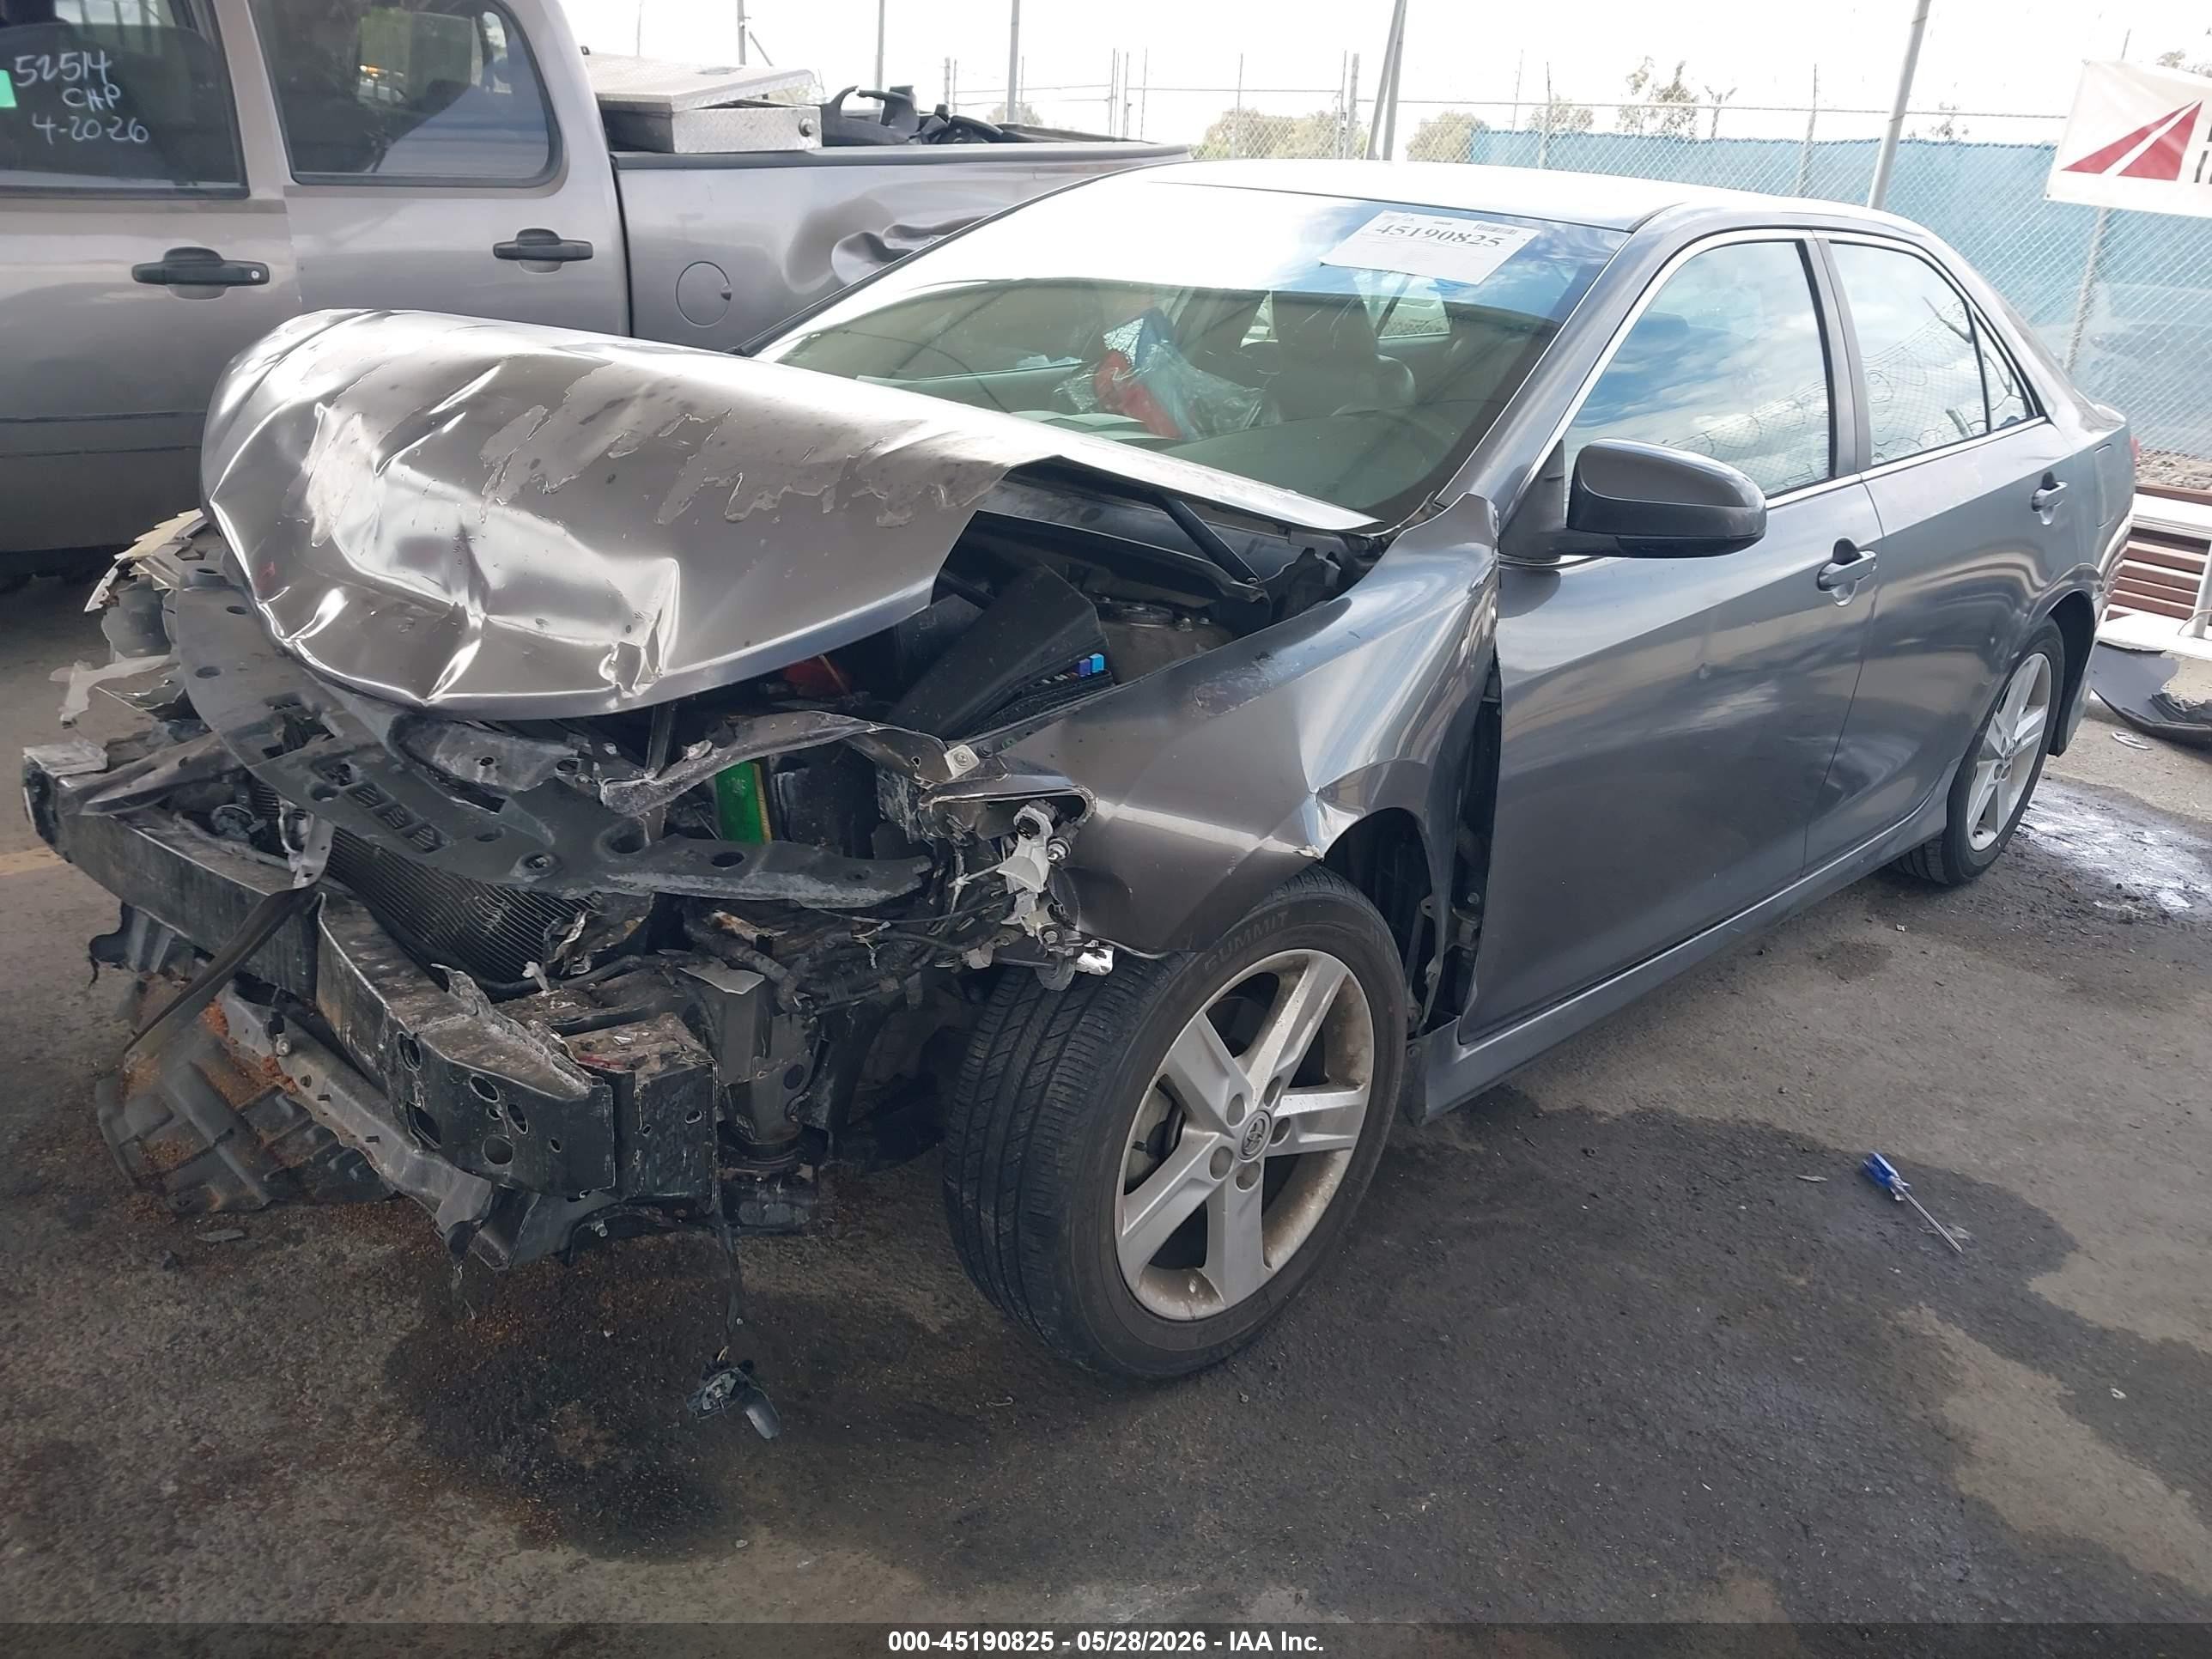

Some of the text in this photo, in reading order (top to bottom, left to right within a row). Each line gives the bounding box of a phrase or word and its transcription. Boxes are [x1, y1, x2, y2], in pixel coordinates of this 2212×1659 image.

[14, 49, 112, 87] 52514
[62, 83, 121, 112] CHP
[1376, 224, 1505, 247] 45190825
